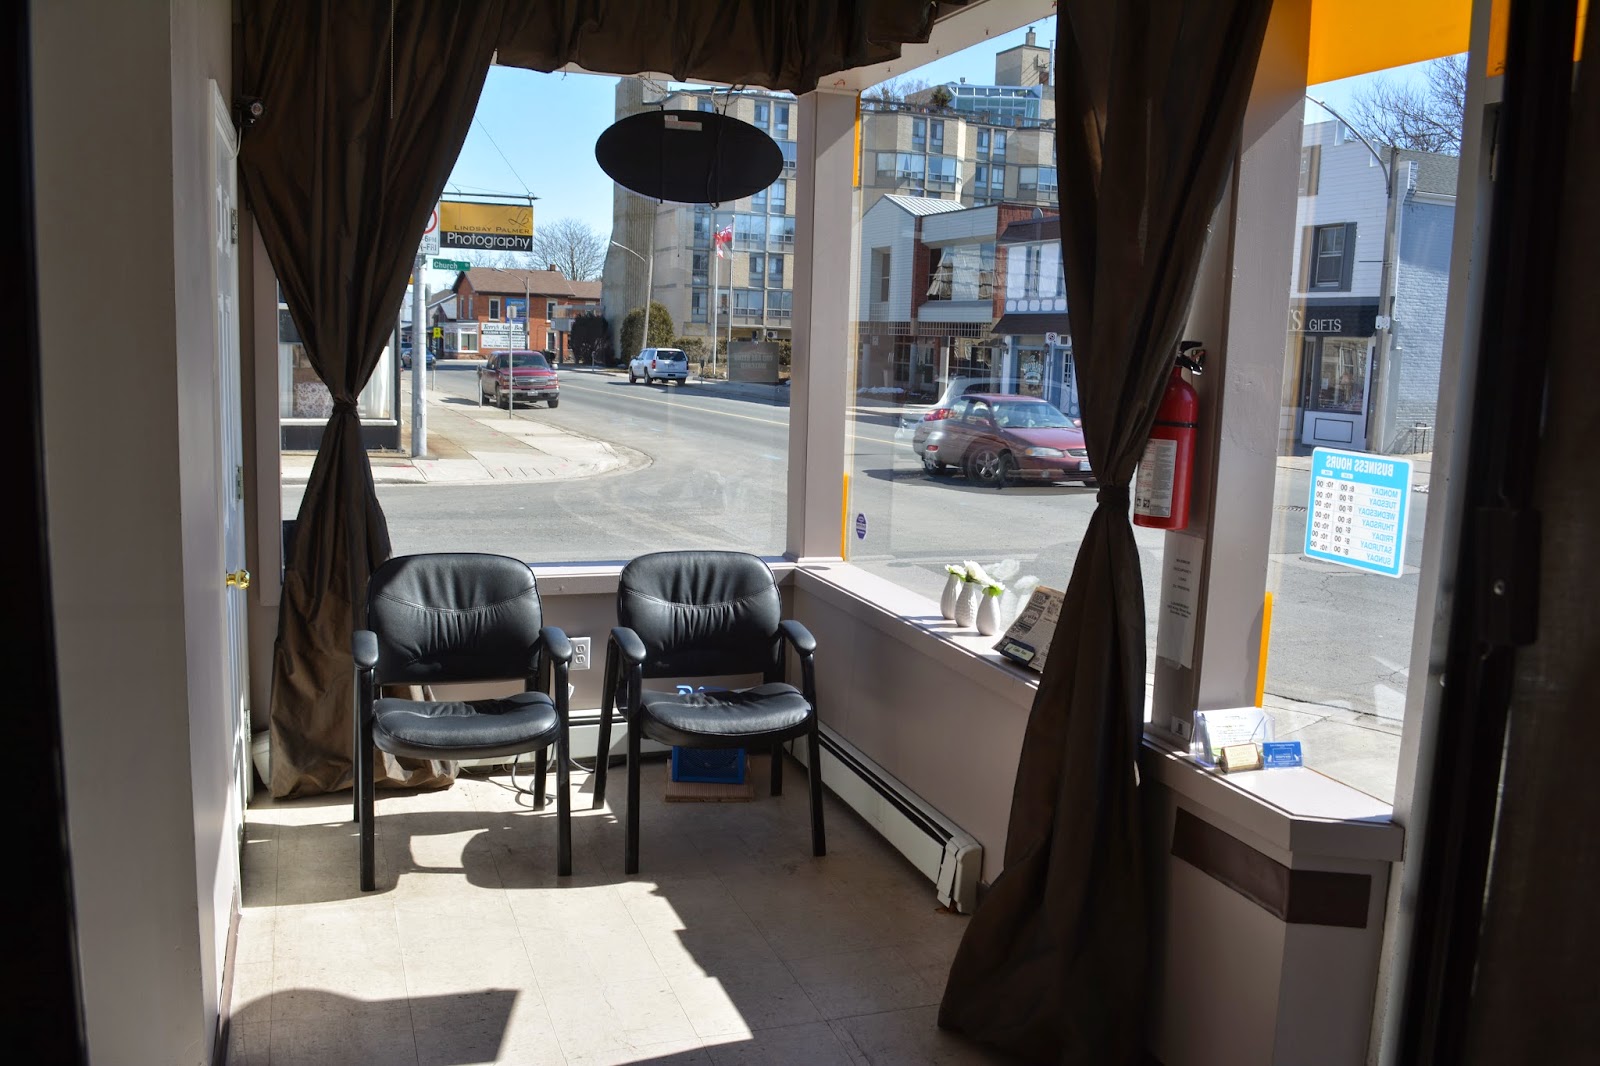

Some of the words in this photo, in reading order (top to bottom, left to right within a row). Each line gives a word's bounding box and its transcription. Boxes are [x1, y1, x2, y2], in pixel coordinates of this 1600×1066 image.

[447, 232, 530, 250] Photography
[433, 261, 458, 269] Church
[1309, 319, 1342, 331] GIFTS
